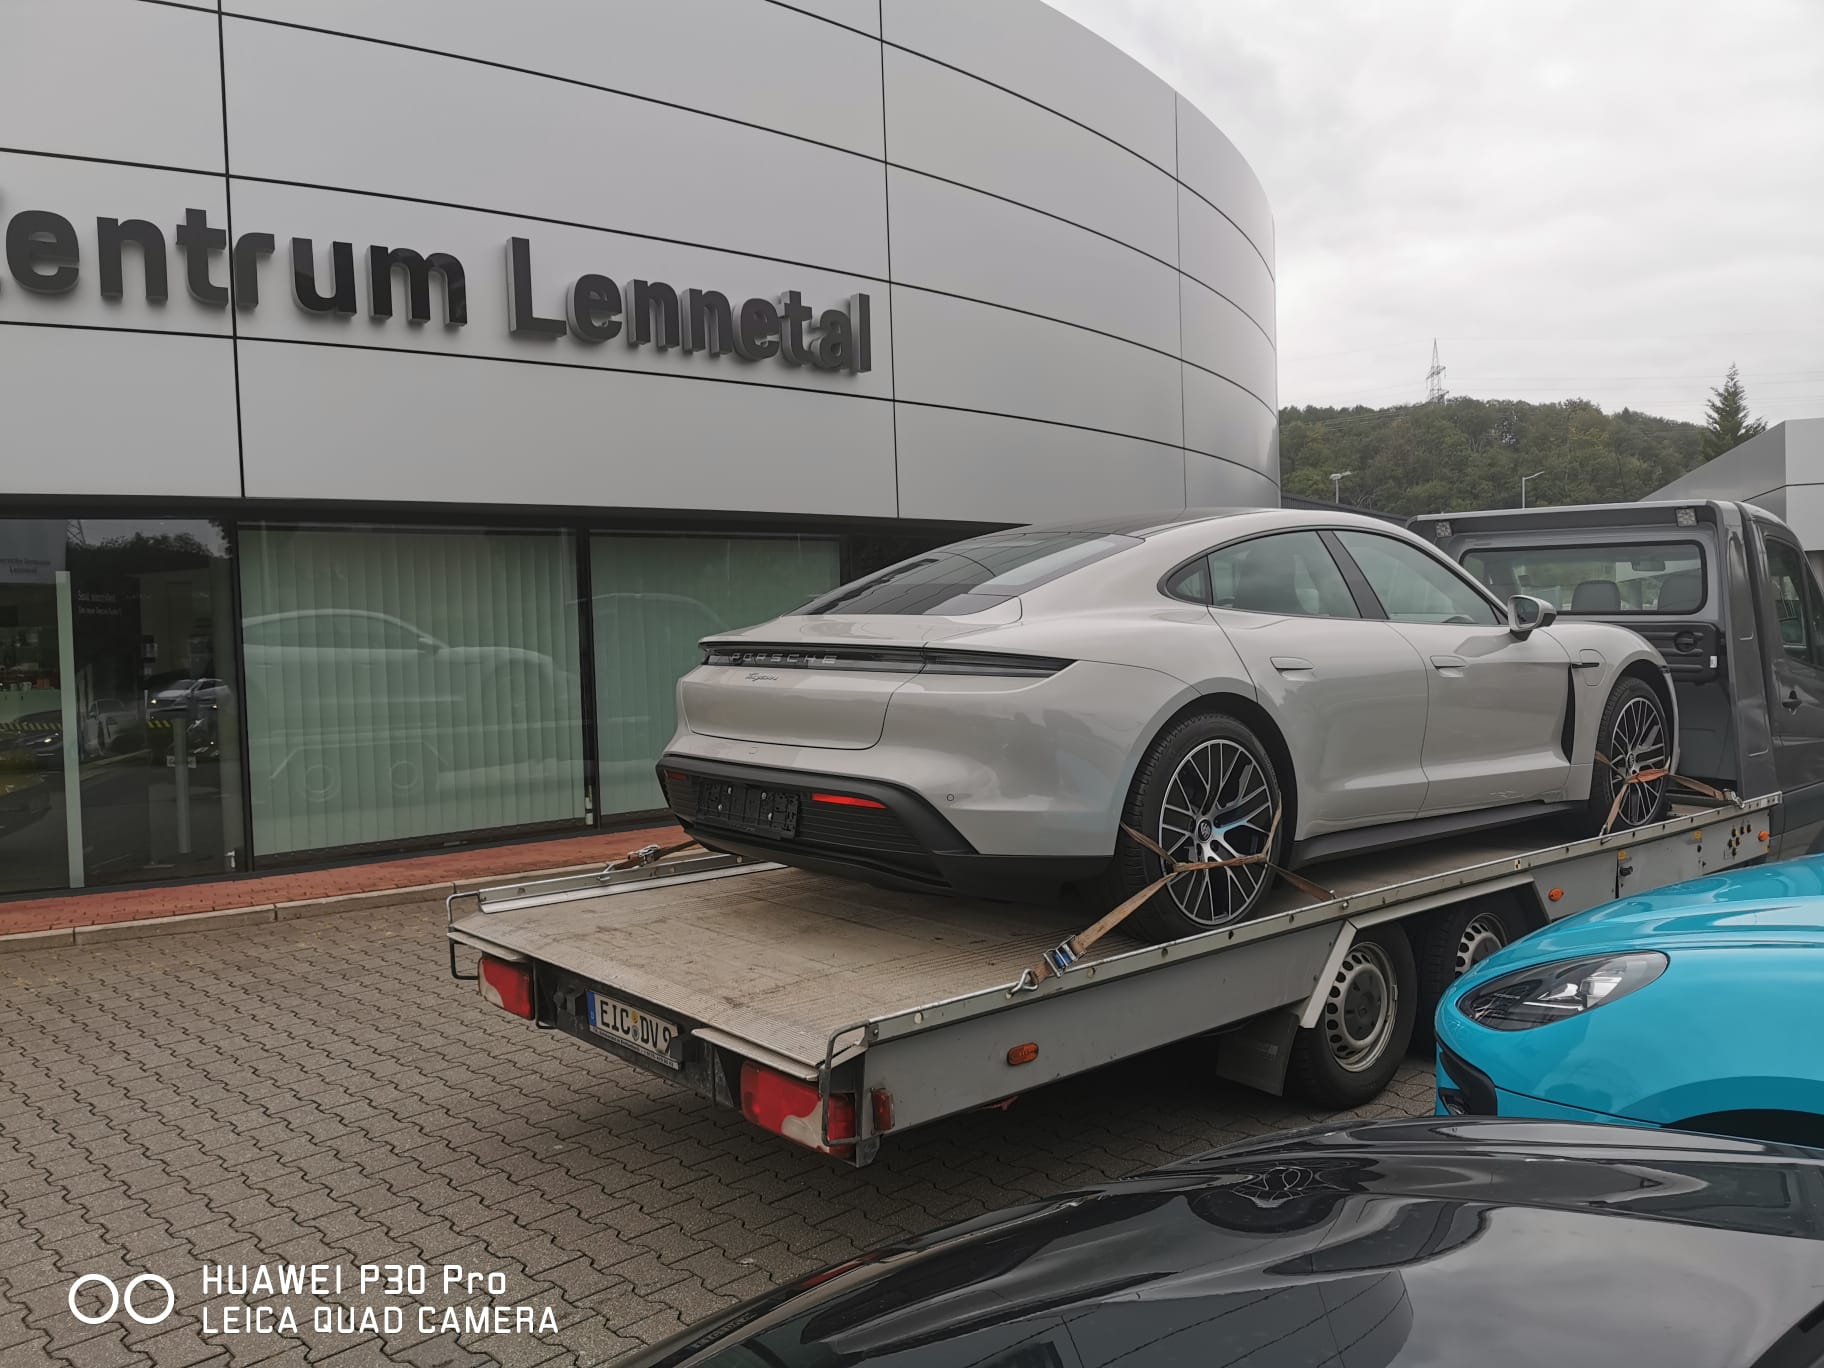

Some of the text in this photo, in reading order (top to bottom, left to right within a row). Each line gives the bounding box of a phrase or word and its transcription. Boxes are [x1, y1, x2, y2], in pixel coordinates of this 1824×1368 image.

[0, 207, 872, 374] entrum Lennetal
[729, 651, 838, 664] PORSCHE
[600, 1000, 631, 1034] EIC
[640, 1016, 659, 1048] DV
